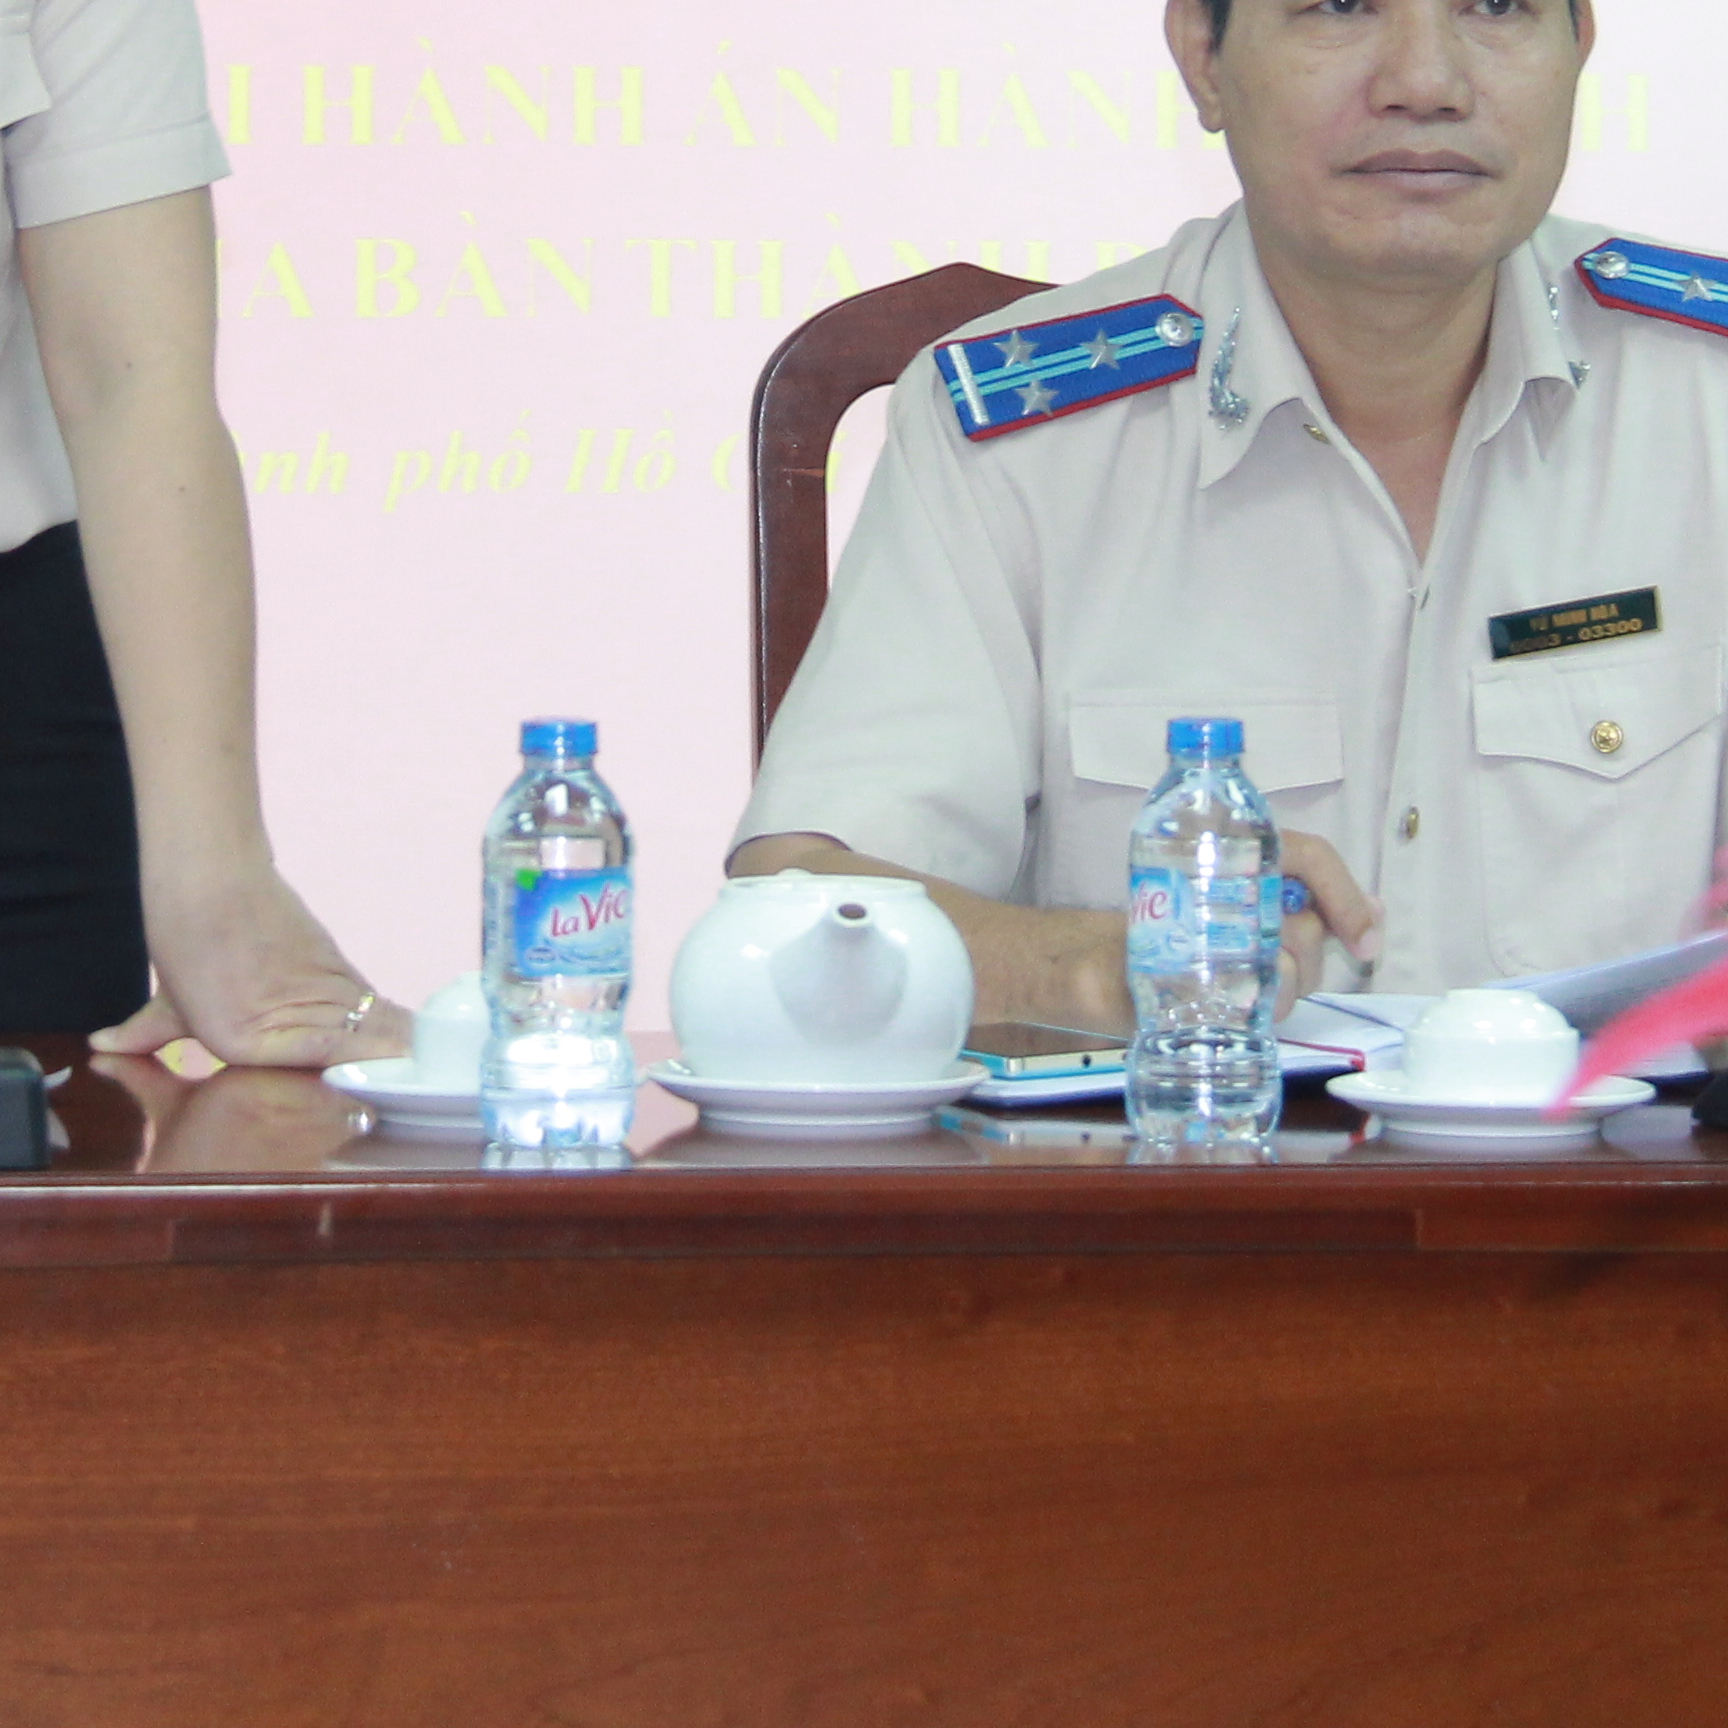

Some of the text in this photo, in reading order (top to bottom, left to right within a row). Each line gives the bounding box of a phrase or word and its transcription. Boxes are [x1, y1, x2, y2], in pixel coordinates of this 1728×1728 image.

[299, 35, 647, 148] HÀNH
[682, 38, 845, 149] ÁN
[353, 209, 598, 319] BÀN
[382, 408, 535, 515] phố
[563, 409, 679, 495] Hồ
